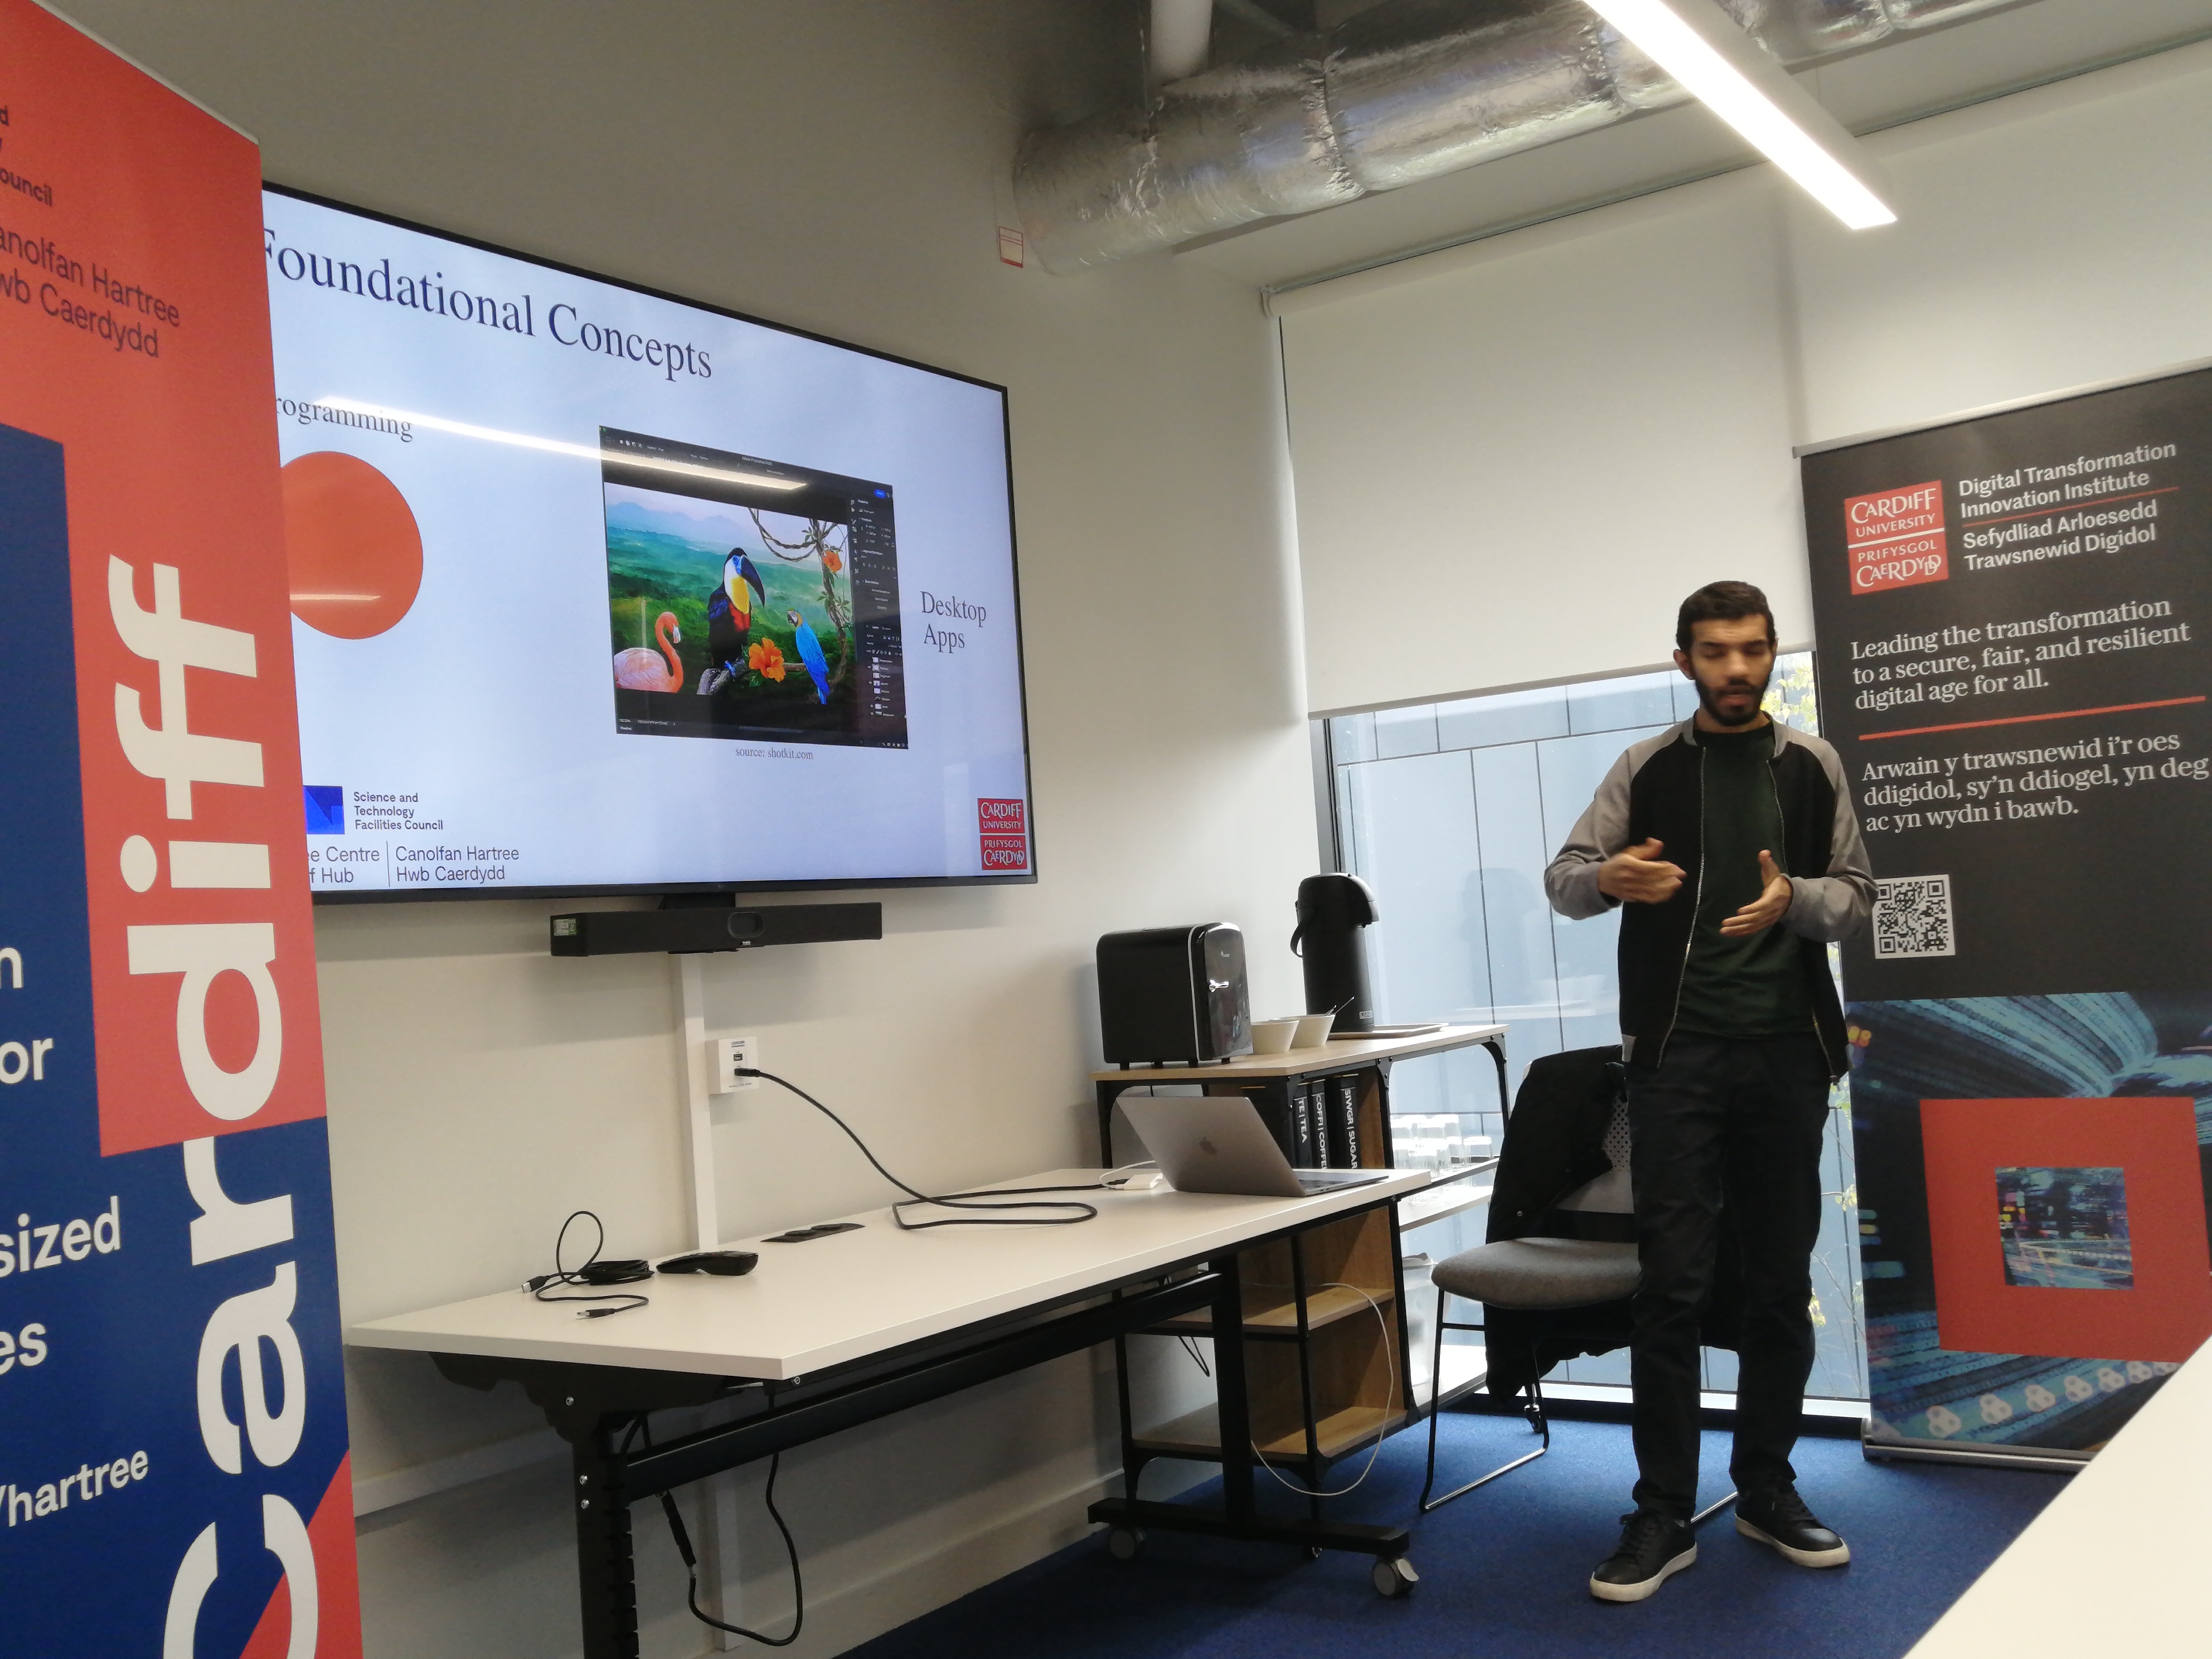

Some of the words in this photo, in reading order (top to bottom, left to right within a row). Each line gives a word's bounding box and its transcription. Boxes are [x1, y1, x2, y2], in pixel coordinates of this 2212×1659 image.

[0, 167, 52, 206] ouncil
[0, 225, 84, 287] anolfan
[91, 263, 181, 328] Hartree
[0, 268, 31, 304] wb
[40, 283, 159, 358] Caerdydd
[548, 303, 711, 381] Concepts
[276, 397, 413, 443] ogramming
[1959, 469, 2021, 498] Digital
[2024, 444, 2177, 484] Transformation
[1851, 488, 1936, 524] CARDIFF
[1961, 489, 2061, 520] Innovation
[2065, 471, 2150, 501] Institute
[1856, 513, 1936, 537] UNIVERSITY
[1963, 522, 2053, 550] Sefydliad
[2057, 499, 2158, 534] Arloesedd
[1857, 539, 1937, 563] PRIFYSGOL
[1964, 539, 2080, 571] Trawsnewid
[2085, 524, 2157, 554] Digidol
[920, 590, 986, 628] Desktop
[923, 623, 965, 654] Apps
[1851, 631, 1938, 660] Leading
[1942, 625, 1982, 648] the
[1985, 600, 2172, 641] transformation
[1852, 666, 1875, 685] to
[1878, 665, 1892, 681] a
[1895, 654, 1977, 680] secure,
[1981, 646, 2031, 667] fair,
[2035, 637, 2082, 661] and
[2086, 622, 2192, 654] resilient
[1855, 681, 1924, 711] digital
[1928, 681, 1968, 704] age
[1972, 672, 2009, 695] for
[2012, 667, 2049, 690] all.
[735, 748, 764, 758] source:
[1861, 755, 1941, 781] Arwain
[1944, 756, 1960, 777] y
[1963, 740, 2103, 769] trawsnewid
[2137, 733, 2180, 754] oes
[353, 792, 396, 802] Science
[399, 792, 418, 803] and
[1864, 780, 1962, 808] ddigidol,
[2019, 763, 2119, 790] ddiogel,
[2122, 764, 2155, 787] yn
[2160, 755, 2210, 781] deg
[354, 806, 415, 818] Technology
[355, 819, 401, 830] Facilities
[404, 819, 443, 831] Council
[981, 802, 1022, 818] CARDIFF
[983, 821, 1021, 829] UNIVERSITY
[1866, 816, 1890, 832] ac
[1894, 813, 1921, 833] yn
[1925, 803, 1991, 829] wydn
[1994, 800, 2002, 821] i
[2006, 796, 2079, 821] bawb.
[326, 846, 380, 862] Centre
[395, 846, 462, 861] Canolfan
[467, 845, 519, 860] Hartree
[984, 840, 1022, 848] PRIFYSGOL
[322, 867, 354, 883] Hub
[397, 866, 429, 882] Hwb
[435, 865, 505, 884] Caerdydd
[1316, 1094, 1325, 1127] COFFI
[1345, 1089, 1355, 1126] SIWGR
[1299, 1118, 1308, 1143] TEA
[1348, 1130, 1358, 1169] SUGAR
